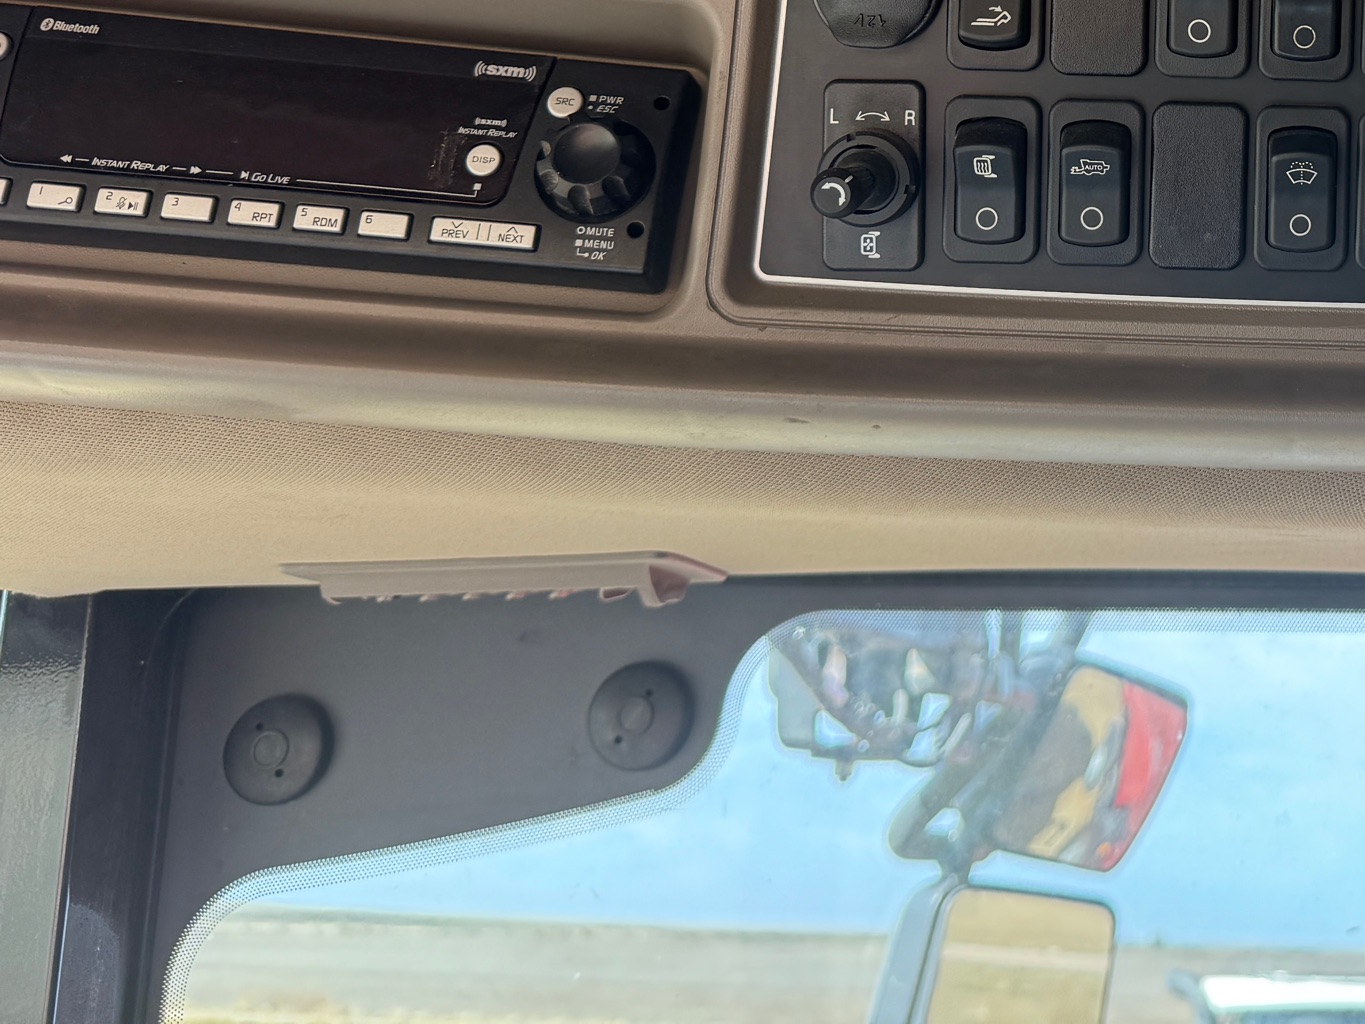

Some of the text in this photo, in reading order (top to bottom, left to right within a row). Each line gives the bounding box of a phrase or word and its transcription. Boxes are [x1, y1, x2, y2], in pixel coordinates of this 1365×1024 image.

[53, 20, 100, 36] Bluetooth
[554, 96, 575, 107] SRC
[598, 95, 624, 105] PWR
[596, 105, 619, 114] ESC
[829, 108, 840, 124] L
[904, 109, 916, 126] R
[457, 126, 518, 138] INSTANT REPLAY
[91, 157, 170, 173] INSTANT REPLAY
[472, 155, 496, 164] DISP
[250, 172, 291, 185] GO LIVE
[105, 191, 114, 201] 2
[171, 197, 180, 207] 3
[234, 202, 242, 212] 4
[251, 211, 274, 223] RPT
[300, 207, 308, 217] 5
[312, 216, 338, 228] RDM
[365, 214, 373, 224] 6
[441, 228, 470, 239] PREV
[586, 227, 615, 237] MUTE
[498, 233, 525, 244] NEXT
[584, 239, 614, 250] MENU
[590, 251, 607, 260] OK
